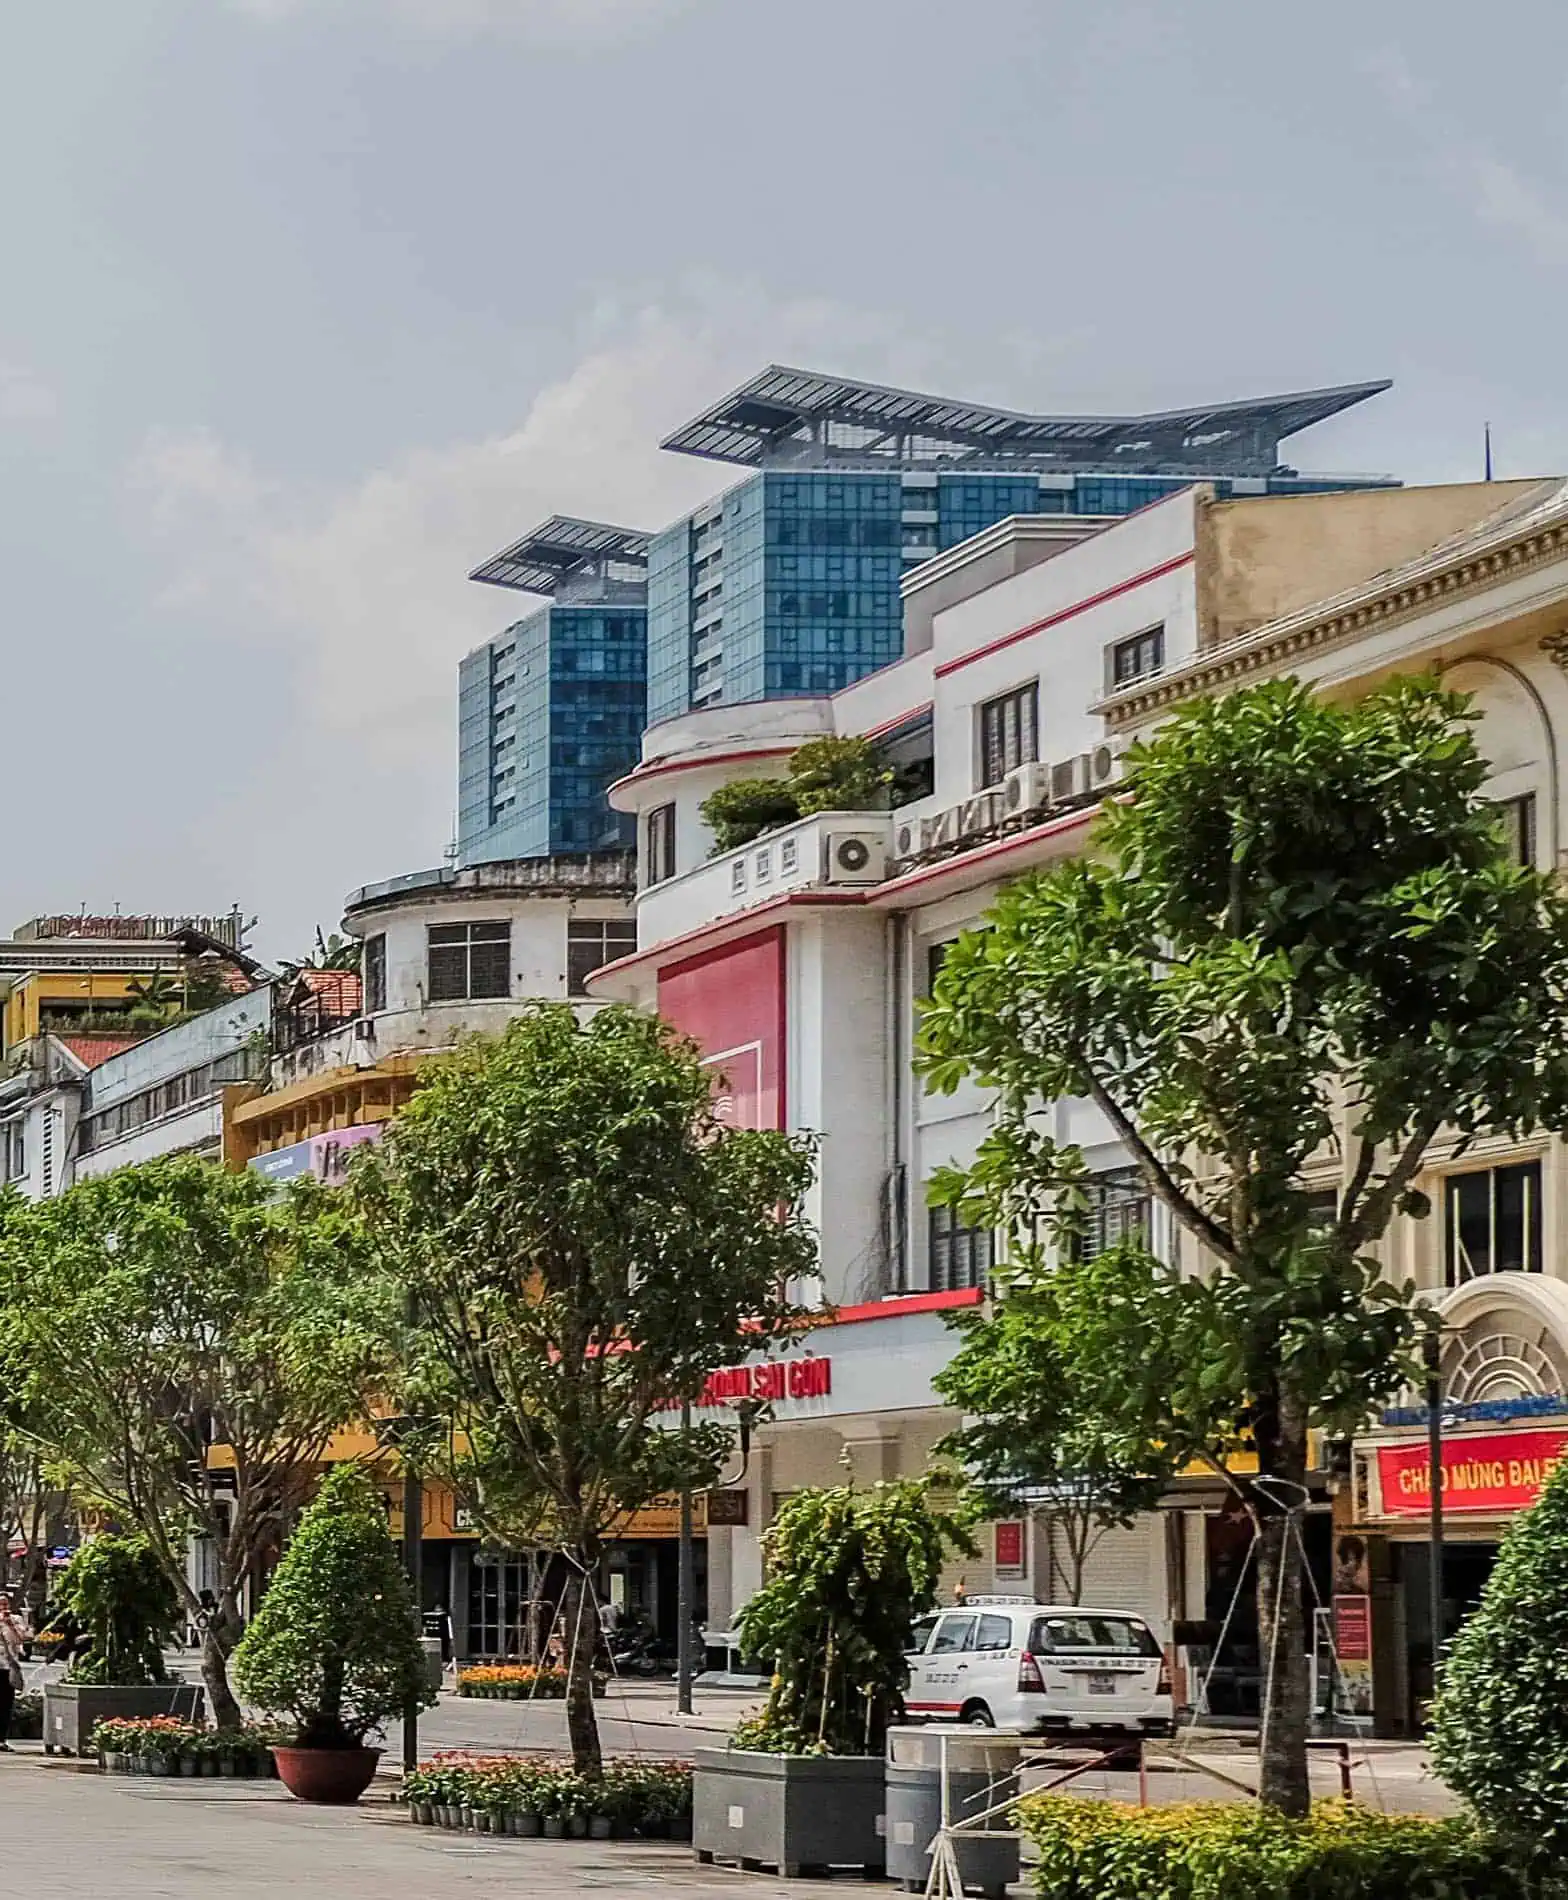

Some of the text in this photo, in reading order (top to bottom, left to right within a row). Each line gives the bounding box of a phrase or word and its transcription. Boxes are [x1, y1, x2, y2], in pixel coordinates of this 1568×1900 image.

[789, 1349, 832, 1398] GÒN
[1451, 1457, 1505, 1491] MỪNG
[1509, 1458, 1541, 1492] ĐẠI
